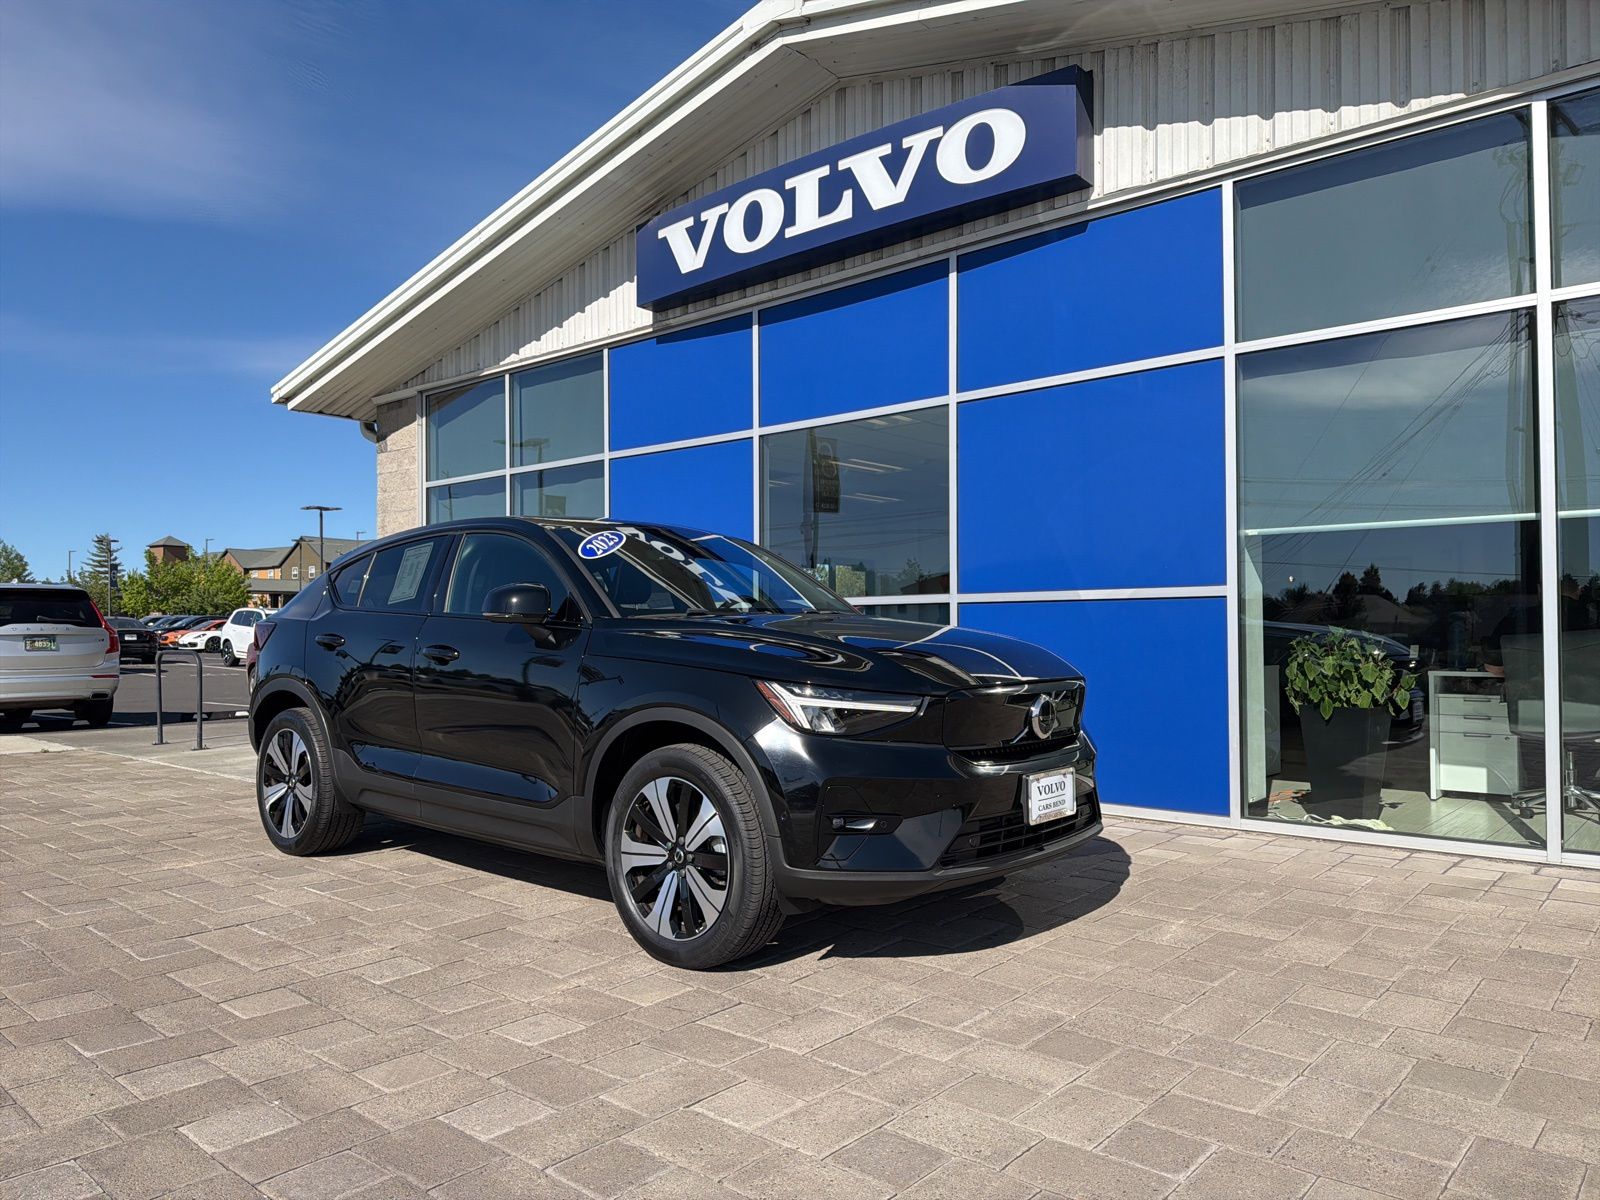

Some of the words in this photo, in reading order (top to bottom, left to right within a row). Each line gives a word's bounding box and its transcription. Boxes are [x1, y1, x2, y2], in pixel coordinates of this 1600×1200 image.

[657, 107, 1027, 275] VOLVO
[586, 532, 619, 556] 2023
[1037, 781, 1066, 796] VOLVO
[1038, 803, 1053, 812] CARS
[1053, 800, 1066, 808] BEND
